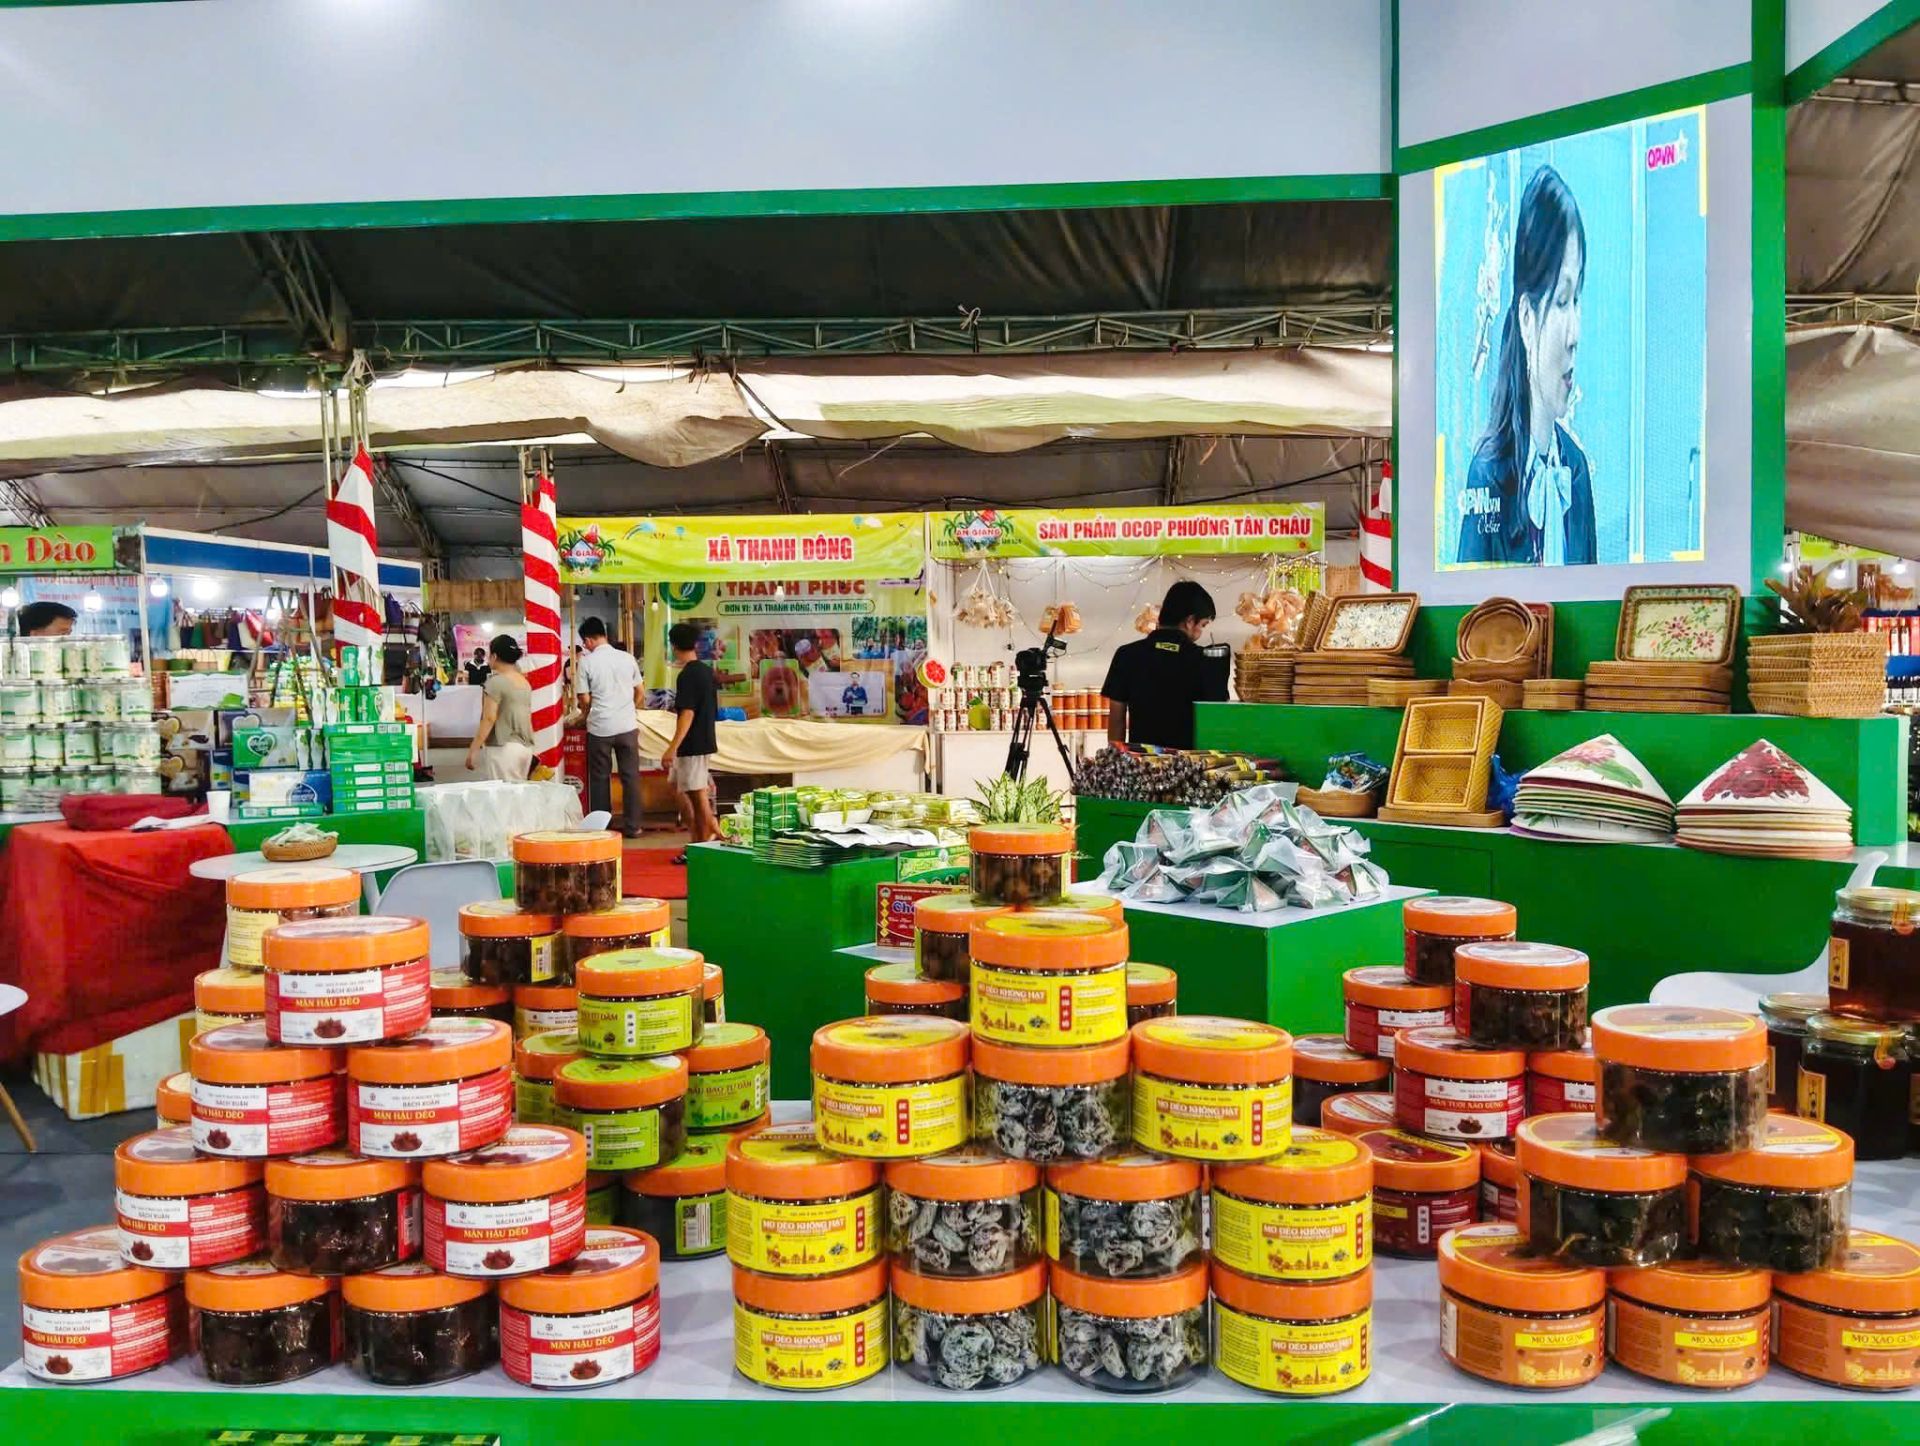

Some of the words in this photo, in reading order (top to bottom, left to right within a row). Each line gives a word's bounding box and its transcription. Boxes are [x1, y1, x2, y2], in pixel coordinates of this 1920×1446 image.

[1074, 516, 1116, 539] PHẨM
[1121, 520, 1163, 538] OCOP
[1167, 517, 1229, 537] PHƯỜNG
[1235, 516, 1263, 536] TÂN
[1268, 513, 1311, 536] CHÂU
[25, 533, 96, 564] Đào
[708, 535, 732, 562] XÃ
